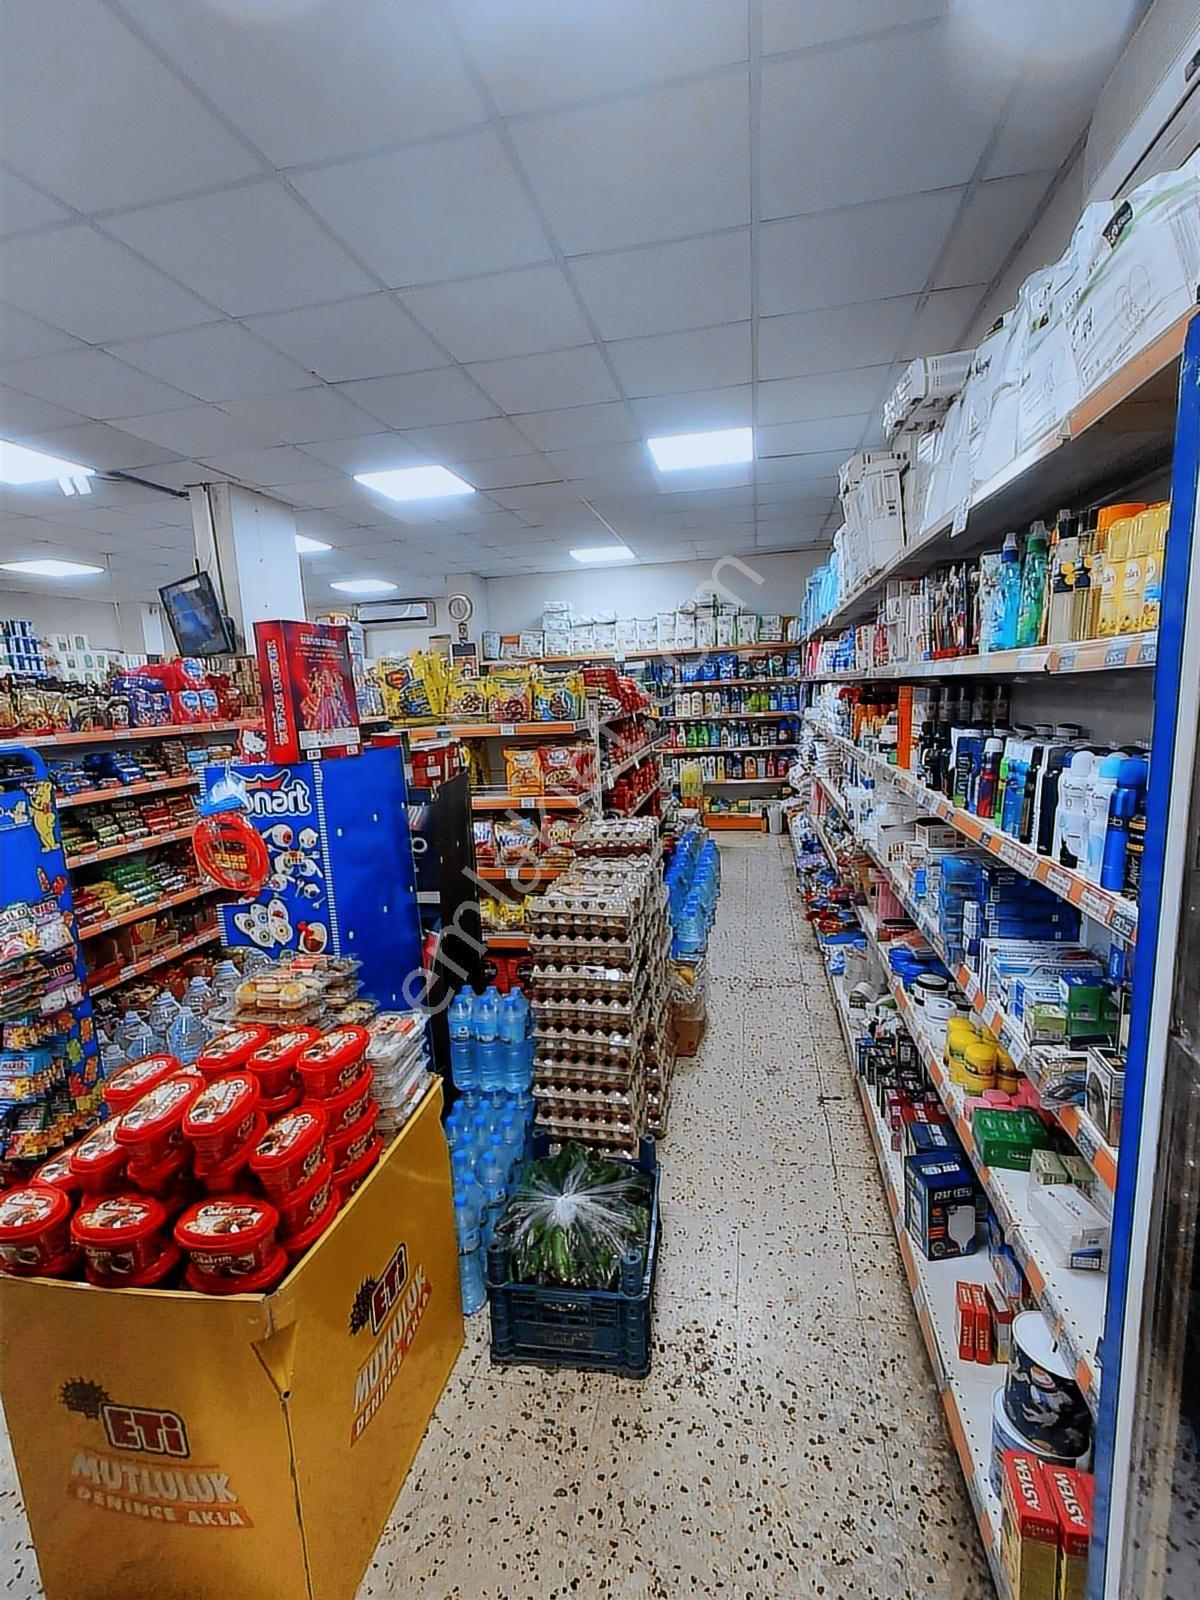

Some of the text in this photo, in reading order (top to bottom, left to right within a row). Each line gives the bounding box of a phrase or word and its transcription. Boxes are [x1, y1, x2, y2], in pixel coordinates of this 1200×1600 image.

[71, 1451, 238, 1503] MUTLULUK
[1014, 1458, 1041, 1512] ASYEM
[1054, 1472, 1087, 1528] ASYEM
[188, 1510, 244, 1526] AKLA
